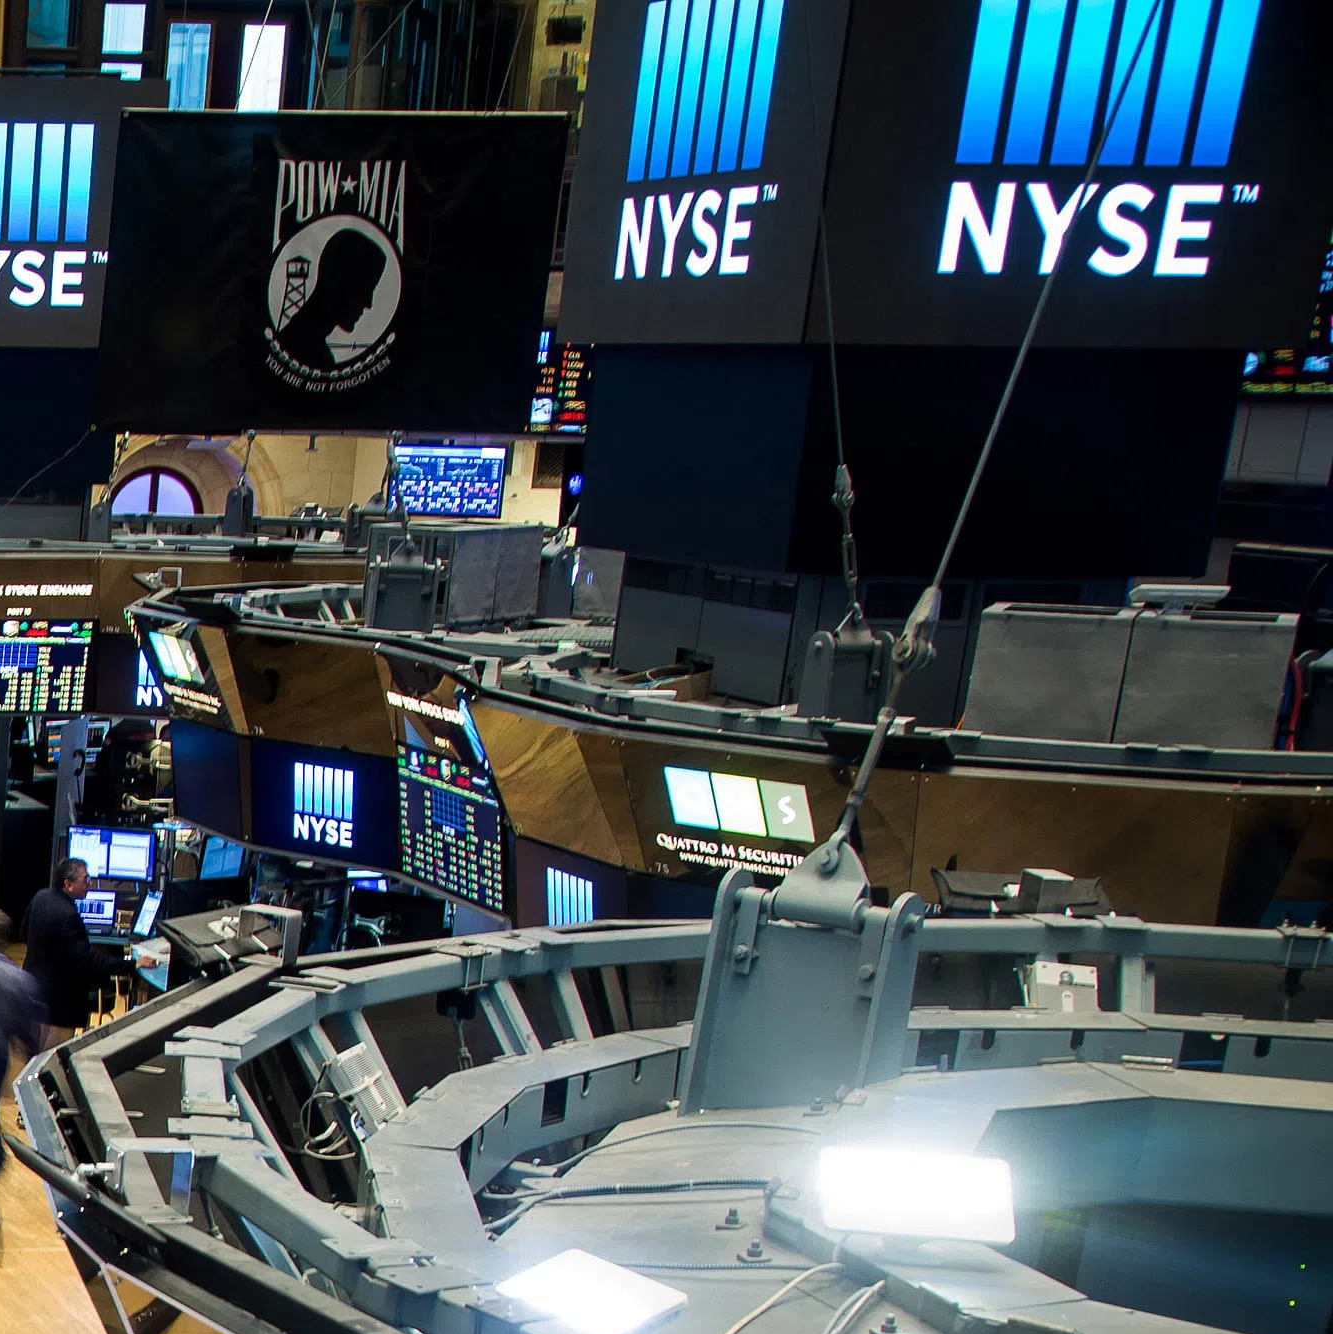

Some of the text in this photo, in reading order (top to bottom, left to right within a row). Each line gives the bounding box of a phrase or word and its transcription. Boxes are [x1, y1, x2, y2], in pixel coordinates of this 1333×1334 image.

[614, 186, 756, 280] NYSE
[938, 181, 1224, 277] NYSE
[306, 381, 327, 392] NOT
[5, 585, 38, 596] STOCK
[40, 584, 94, 596] EXCHANGE
[293, 813, 353, 849] NYSE
[656, 833, 718, 855] QUATTRO
